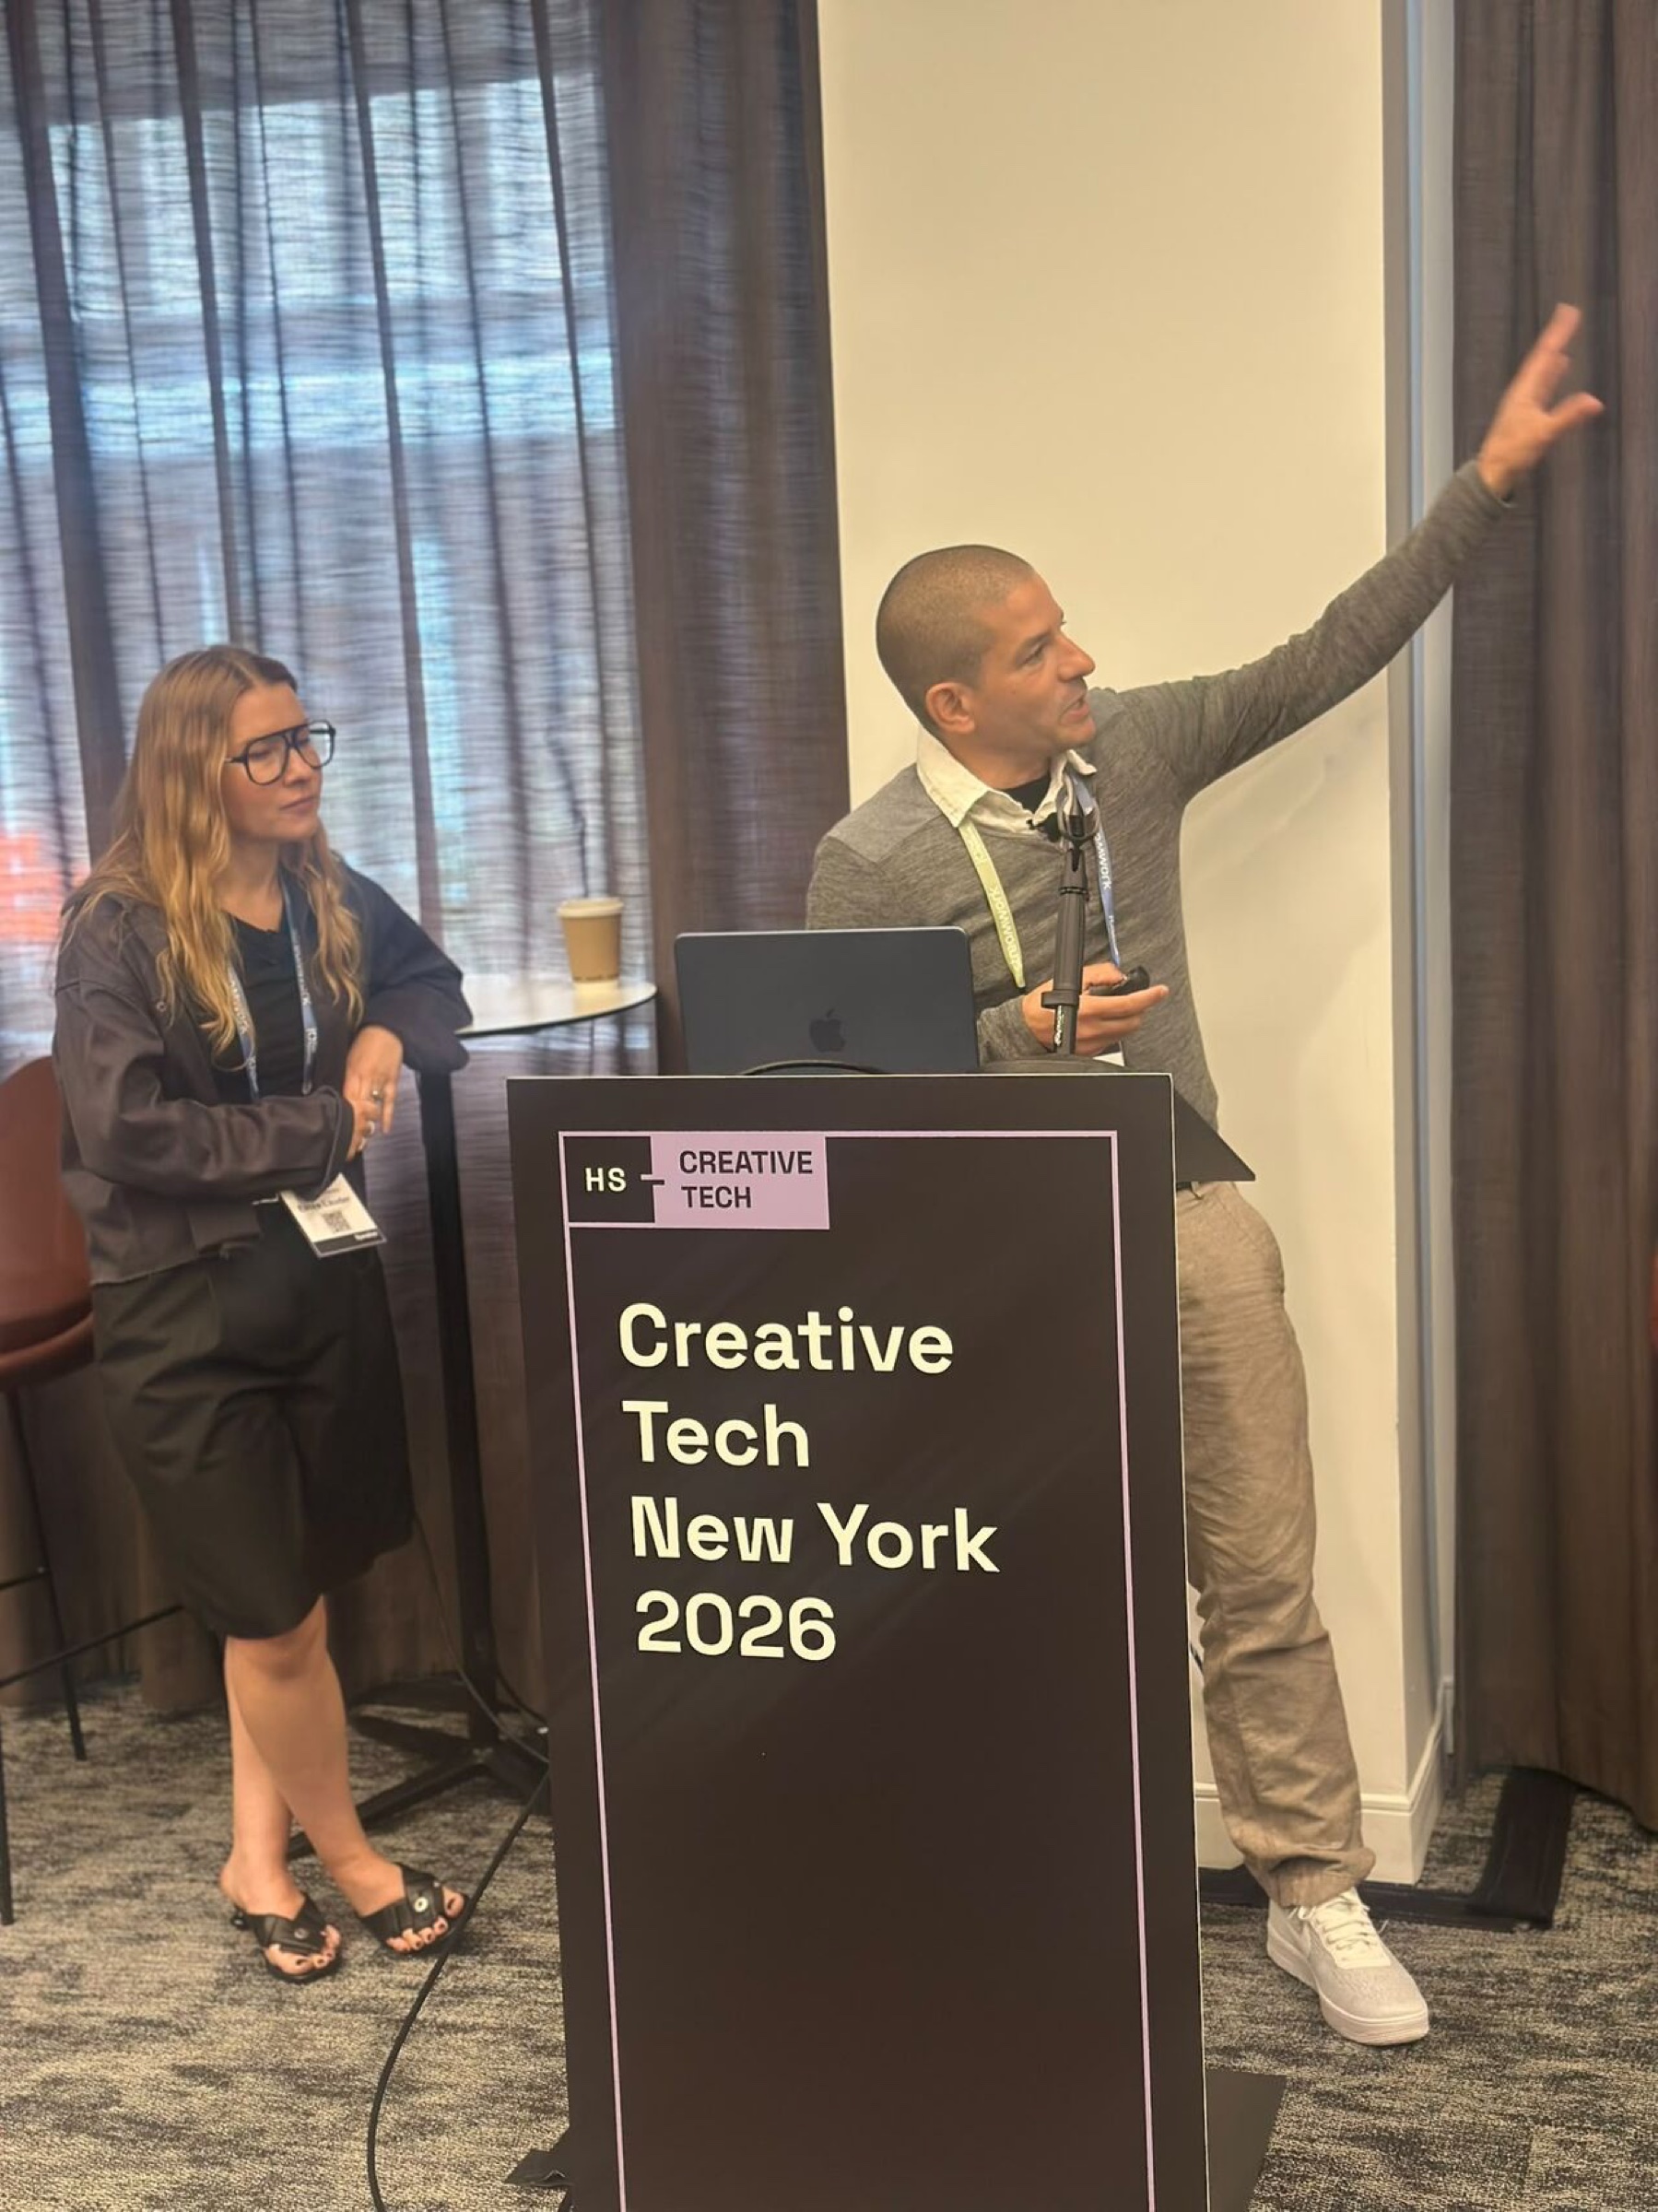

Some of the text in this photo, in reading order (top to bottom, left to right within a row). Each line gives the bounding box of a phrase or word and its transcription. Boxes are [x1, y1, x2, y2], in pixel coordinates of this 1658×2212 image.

[585, 1167, 627, 1192] HS
[679, 1149, 813, 1175] CREATIVE
[680, 1185, 752, 1208] TECH
[619, 1302, 953, 1374] Creative
[622, 1400, 809, 1467] Tech
[631, 1496, 1001, 1572] New York
[636, 1590, 836, 1661] 2026
